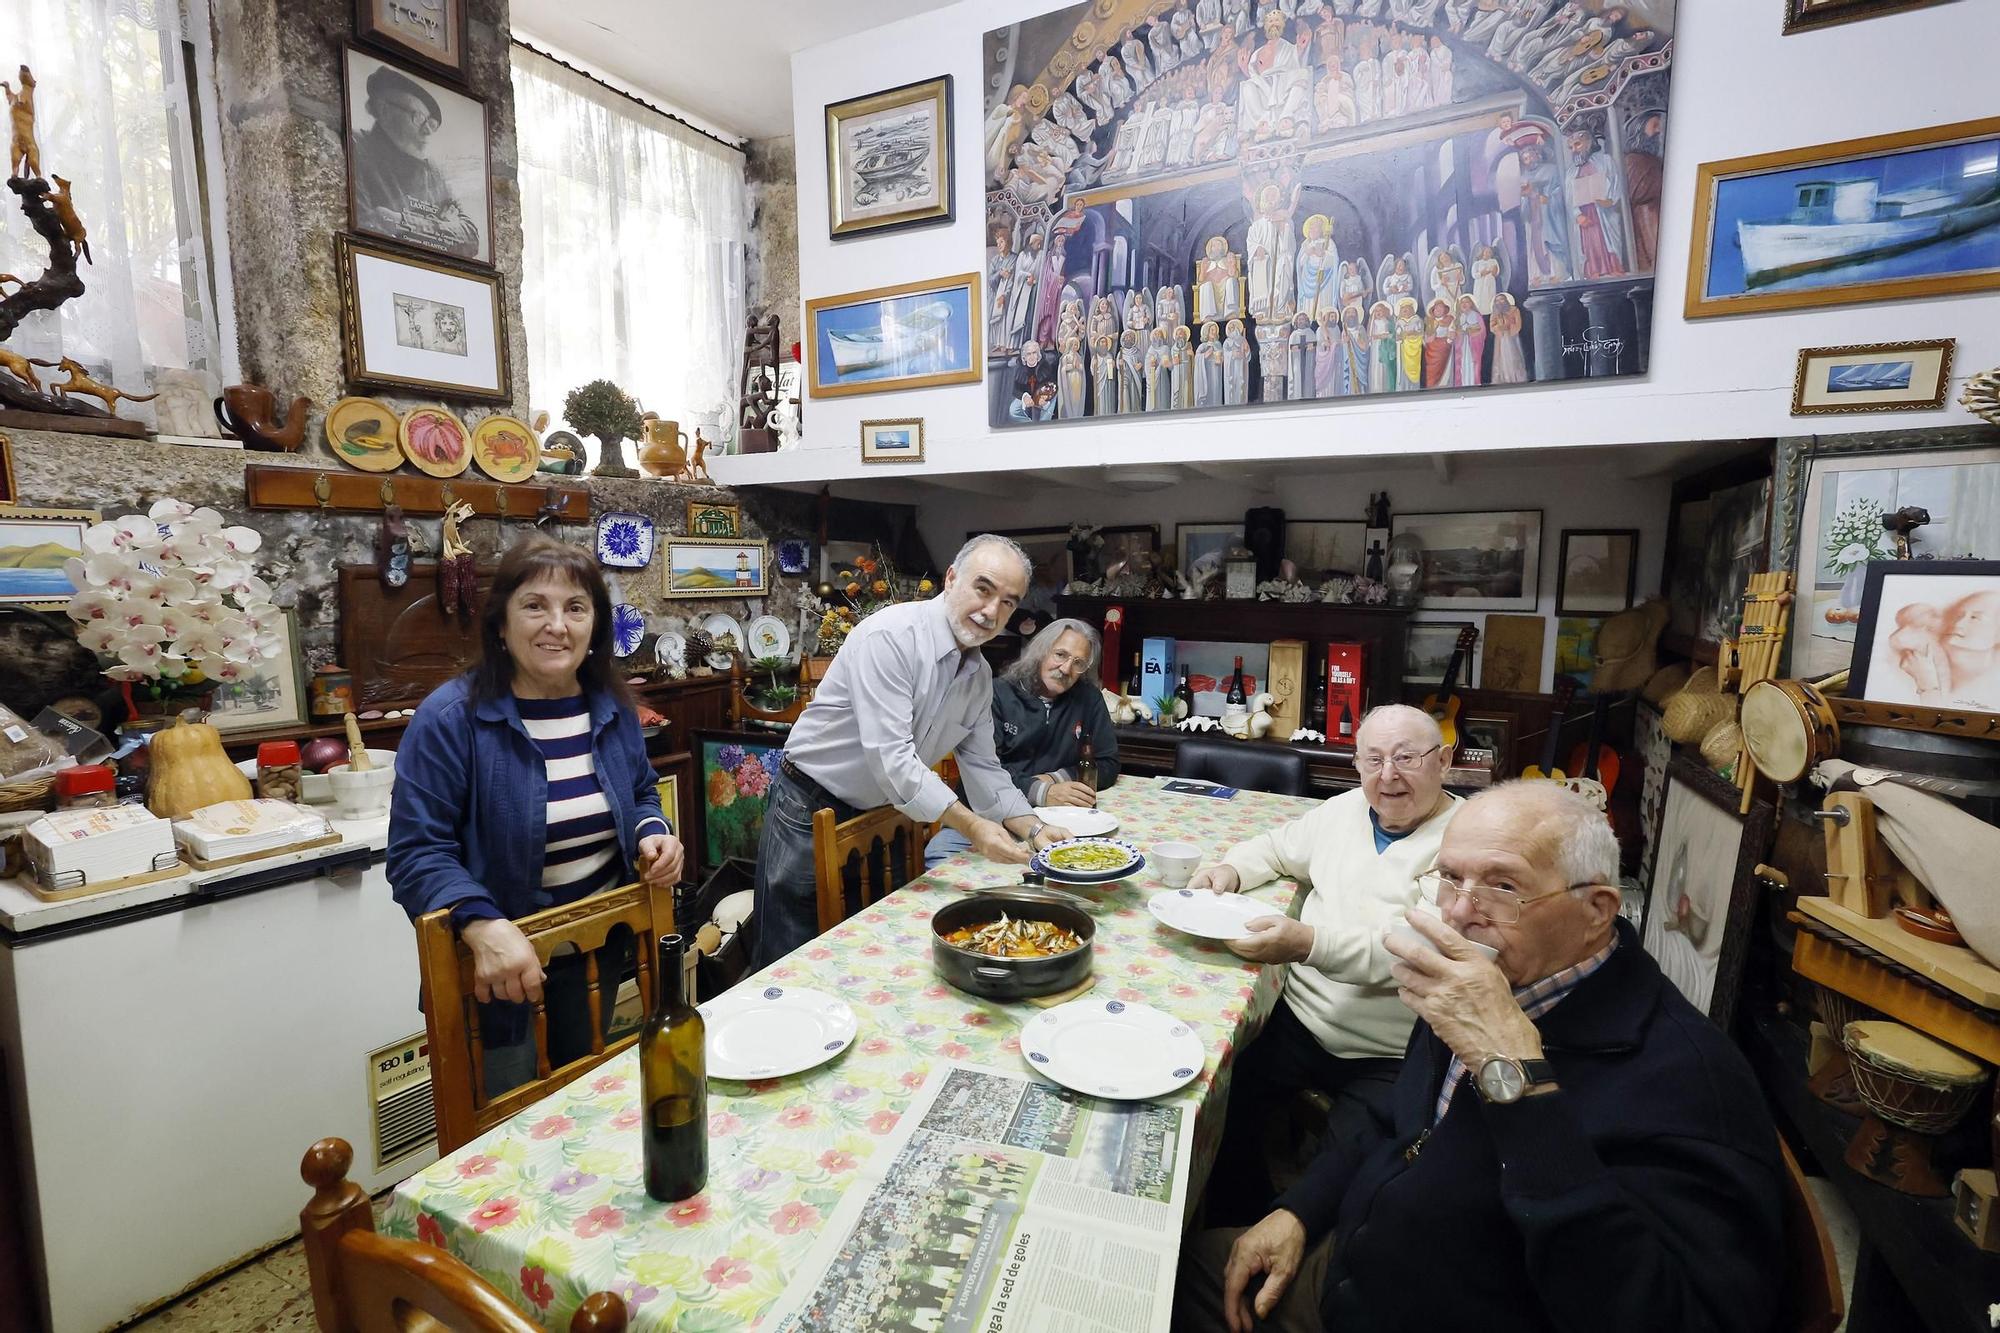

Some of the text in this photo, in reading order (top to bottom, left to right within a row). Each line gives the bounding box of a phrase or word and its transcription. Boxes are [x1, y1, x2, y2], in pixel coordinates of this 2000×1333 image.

[378, 1056, 400, 1072] 180
[392, 1065, 425, 1081] regulating
[1014, 1233, 1031, 1262] goles
[958, 1274, 976, 1308] XUNTOS
[971, 1241, 989, 1273] CONTRA
[987, 1212, 999, 1233] LUME
[1006, 1263, 1021, 1277] de
[1000, 1278, 1015, 1300] sed
[992, 1300, 1007, 1312] la
